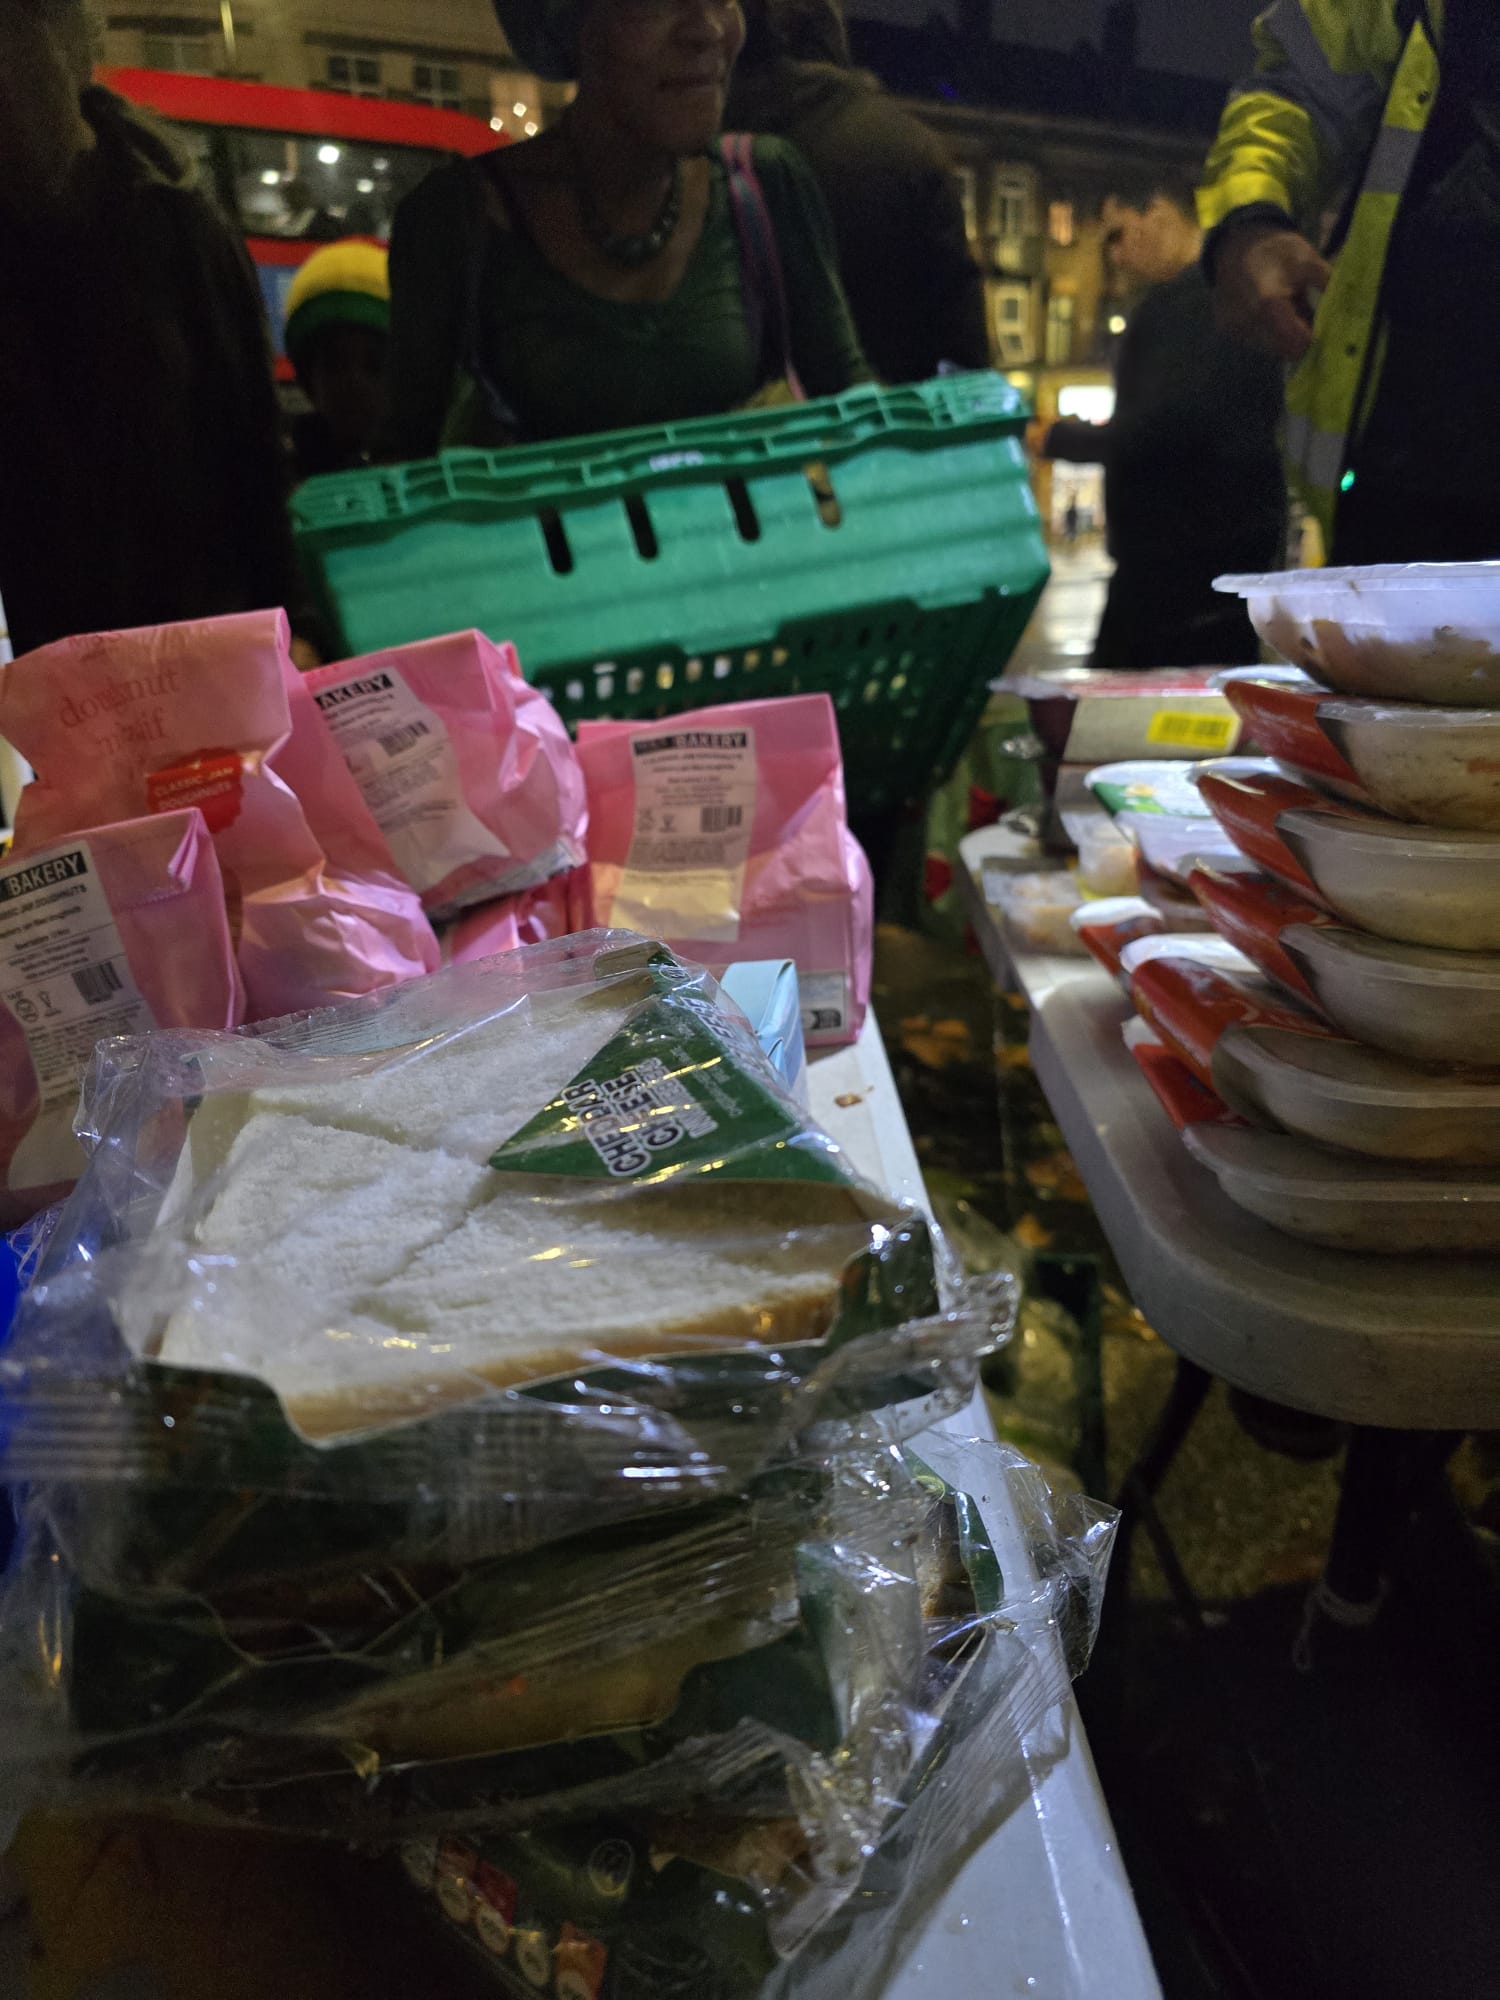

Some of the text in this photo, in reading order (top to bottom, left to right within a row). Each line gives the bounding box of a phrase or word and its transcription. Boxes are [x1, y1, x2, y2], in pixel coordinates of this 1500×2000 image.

[675, 731, 745, 749] BAKERY
[8, 853, 80, 897] BAKERY
[563, 1080, 648, 1174] CHEDDAR
[604, 1072, 682, 1148] CHEESE
